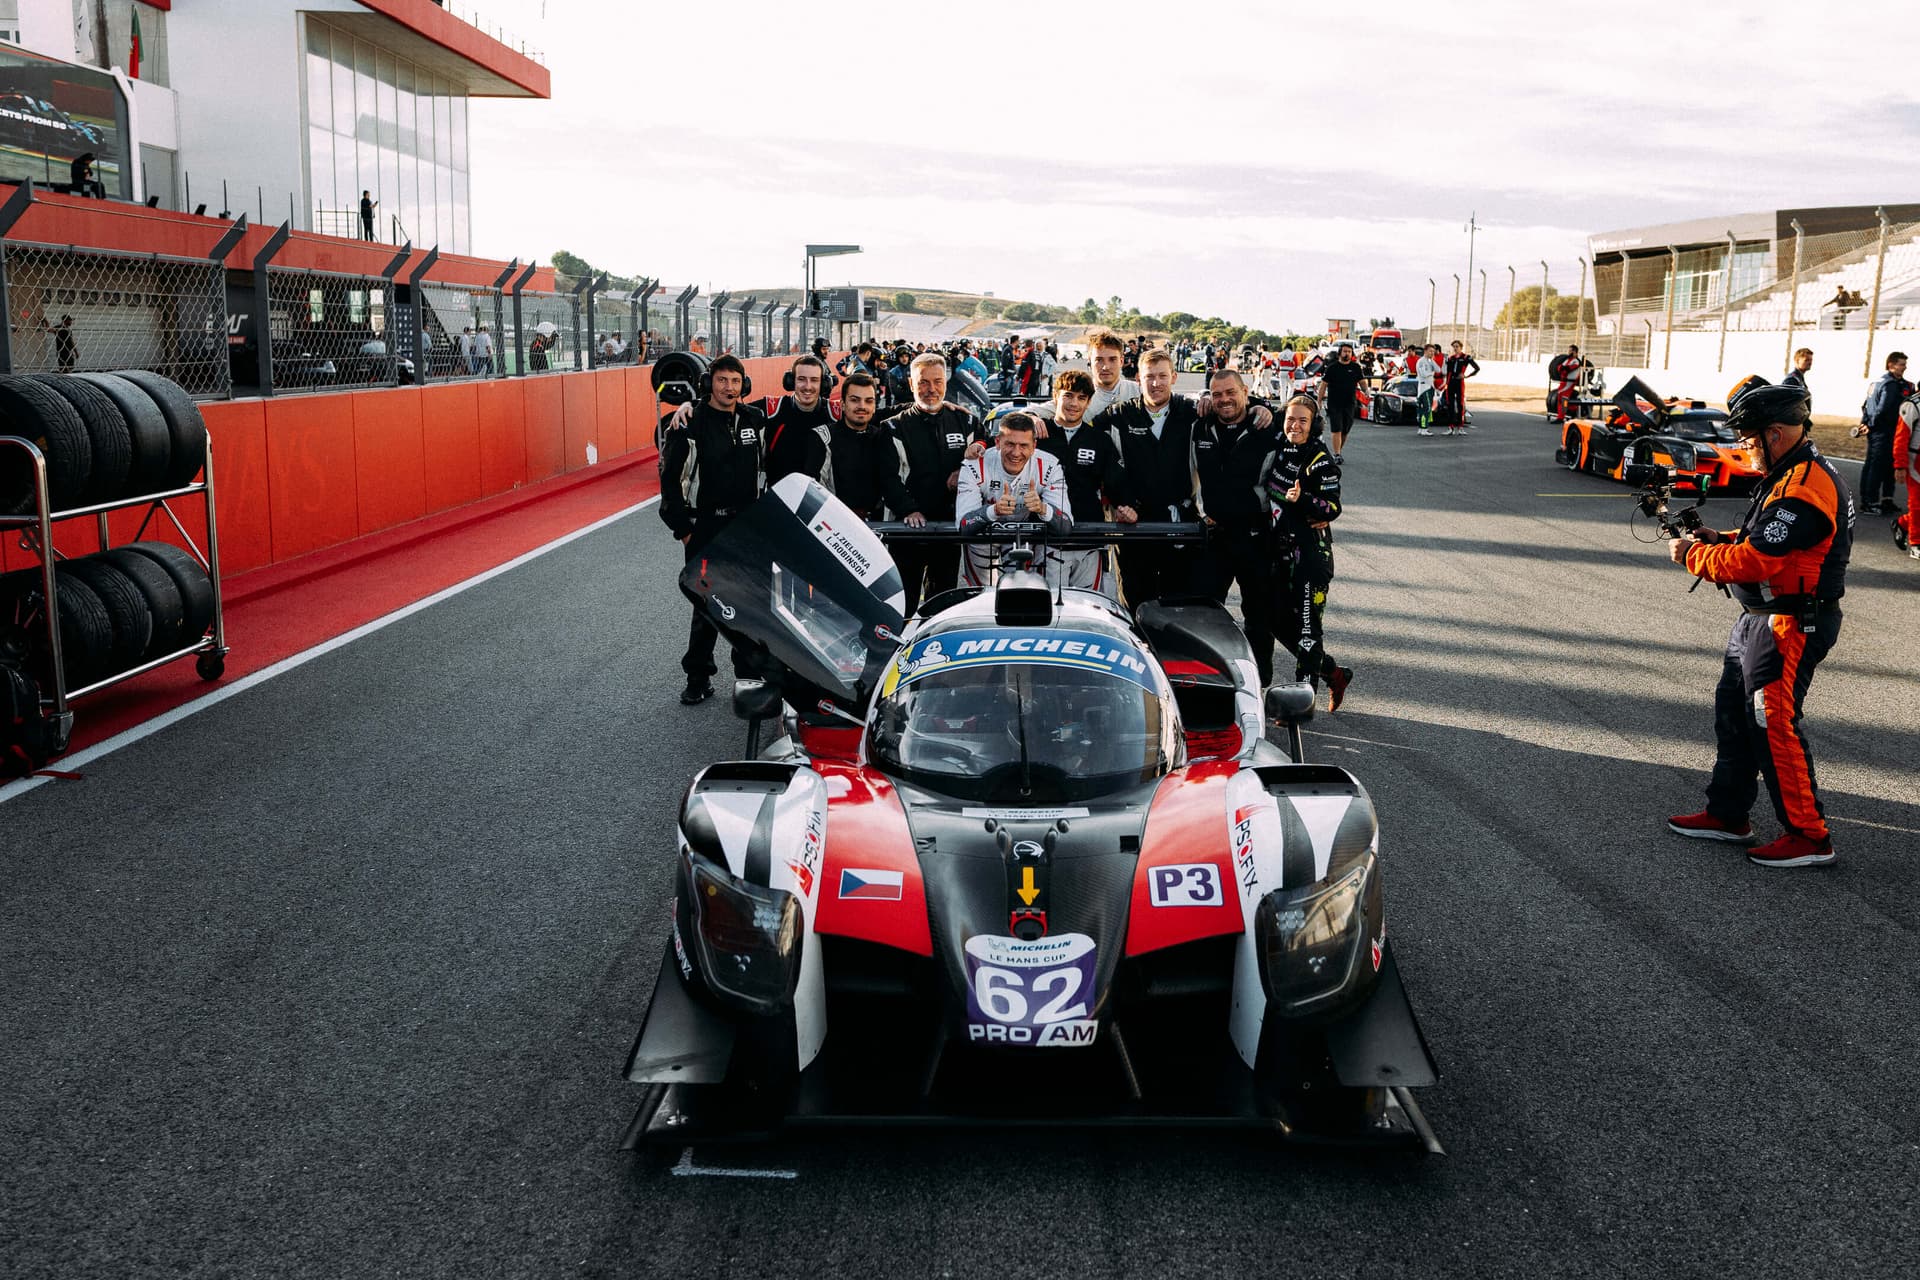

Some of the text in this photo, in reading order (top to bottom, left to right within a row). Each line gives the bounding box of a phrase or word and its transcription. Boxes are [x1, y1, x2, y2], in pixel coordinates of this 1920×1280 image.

[1776, 510, 1797, 522] OMP
[826, 536, 867, 577] L.ROBINSON
[832, 531, 871, 570] J.ZIELONKA
[1302, 599, 1312, 634] Bretton
[956, 637, 1146, 675] MICHELIN
[1235, 819, 1258, 897] PSOFIX
[1155, 867, 1215, 902] P3
[990, 953, 1066, 963] LE MANS CUP
[1010, 940, 1072, 952] MICHELIN
[975, 966, 1087, 1024] 62
[968, 1023, 1095, 1042] PRO AM
